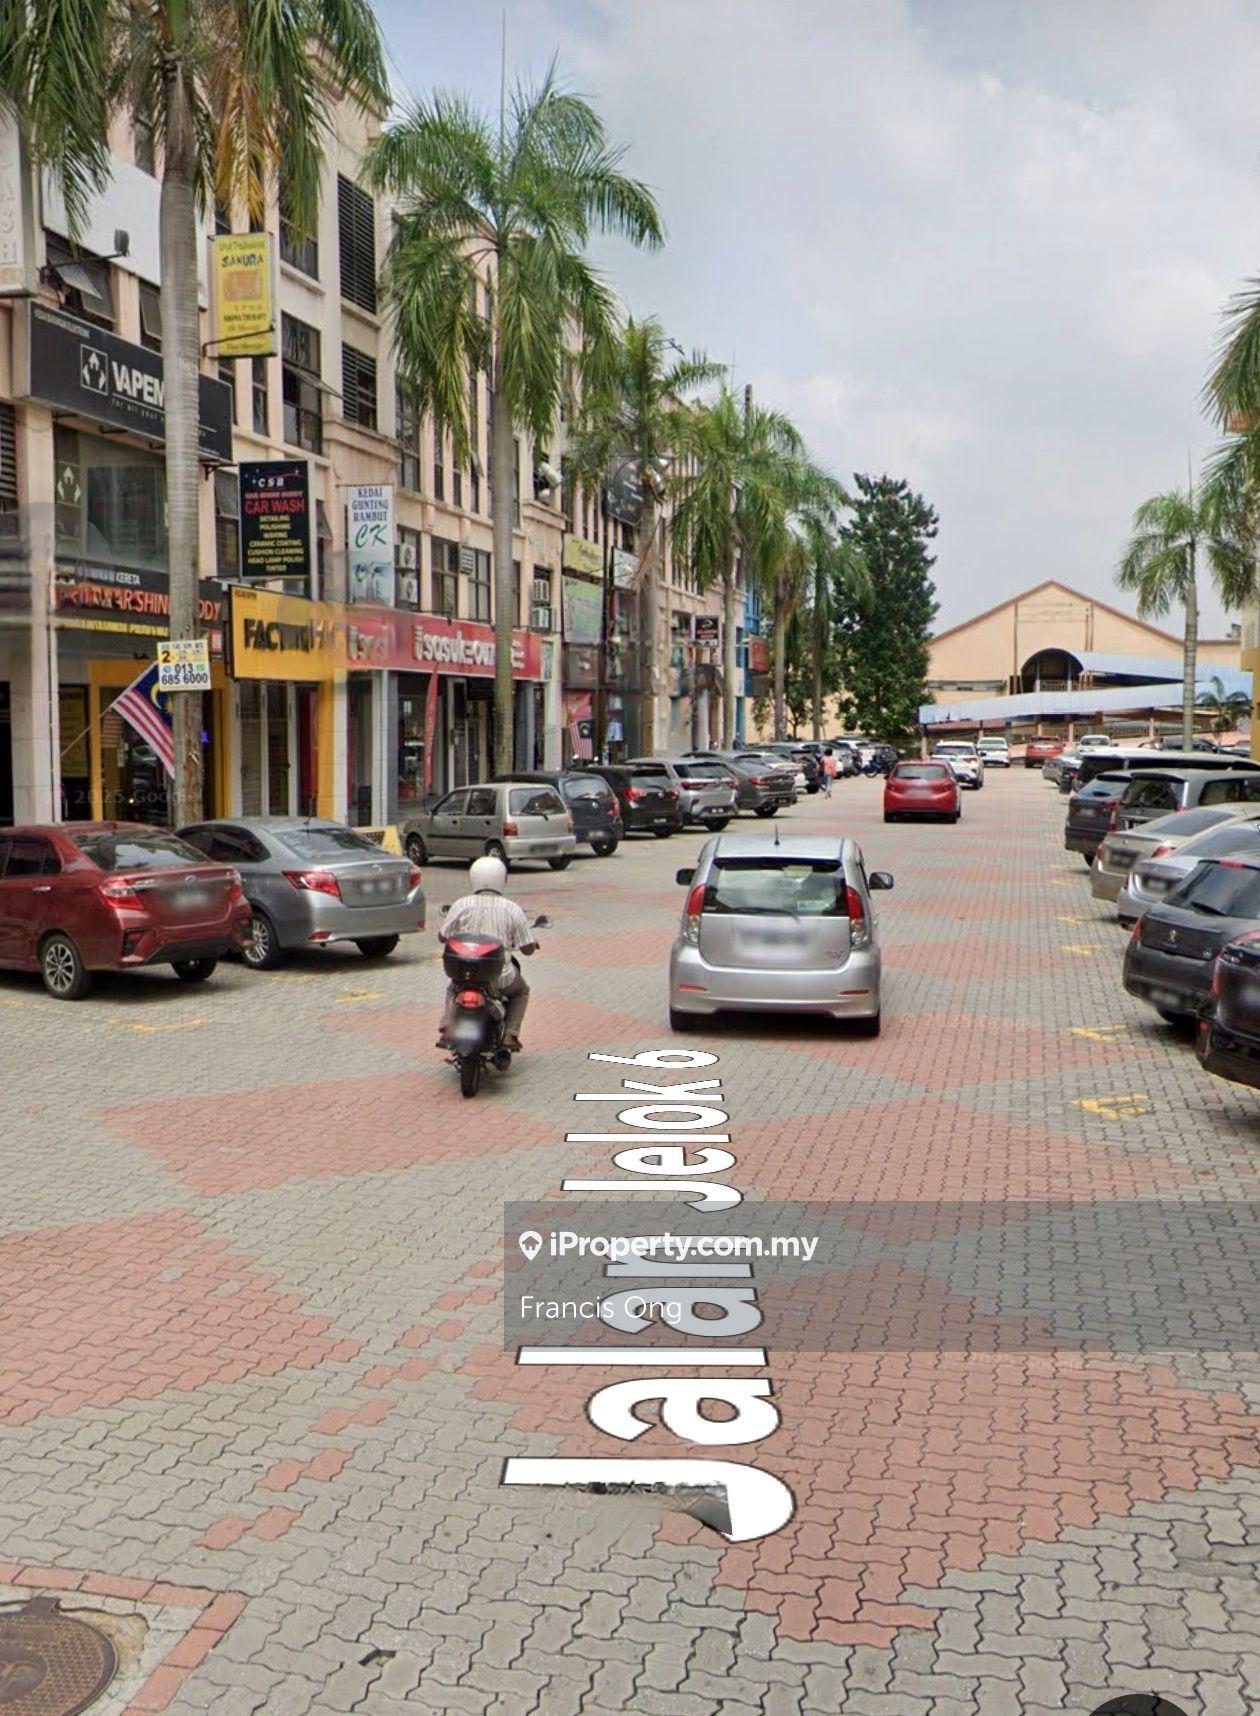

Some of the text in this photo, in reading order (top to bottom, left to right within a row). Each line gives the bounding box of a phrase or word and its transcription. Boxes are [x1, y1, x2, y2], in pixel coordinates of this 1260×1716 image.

[111, 360, 165, 407] VAPEM
[358, 488, 383, 498] KEDAI
[244, 498, 305, 514] CAR WASH
[351, 500, 389, 511] GUNTING
[353, 511, 388, 522] RAMBUT
[161, 650, 171, 663] 2
[174, 663, 194, 674] 013
[161, 673, 208, 685] 685 6000
